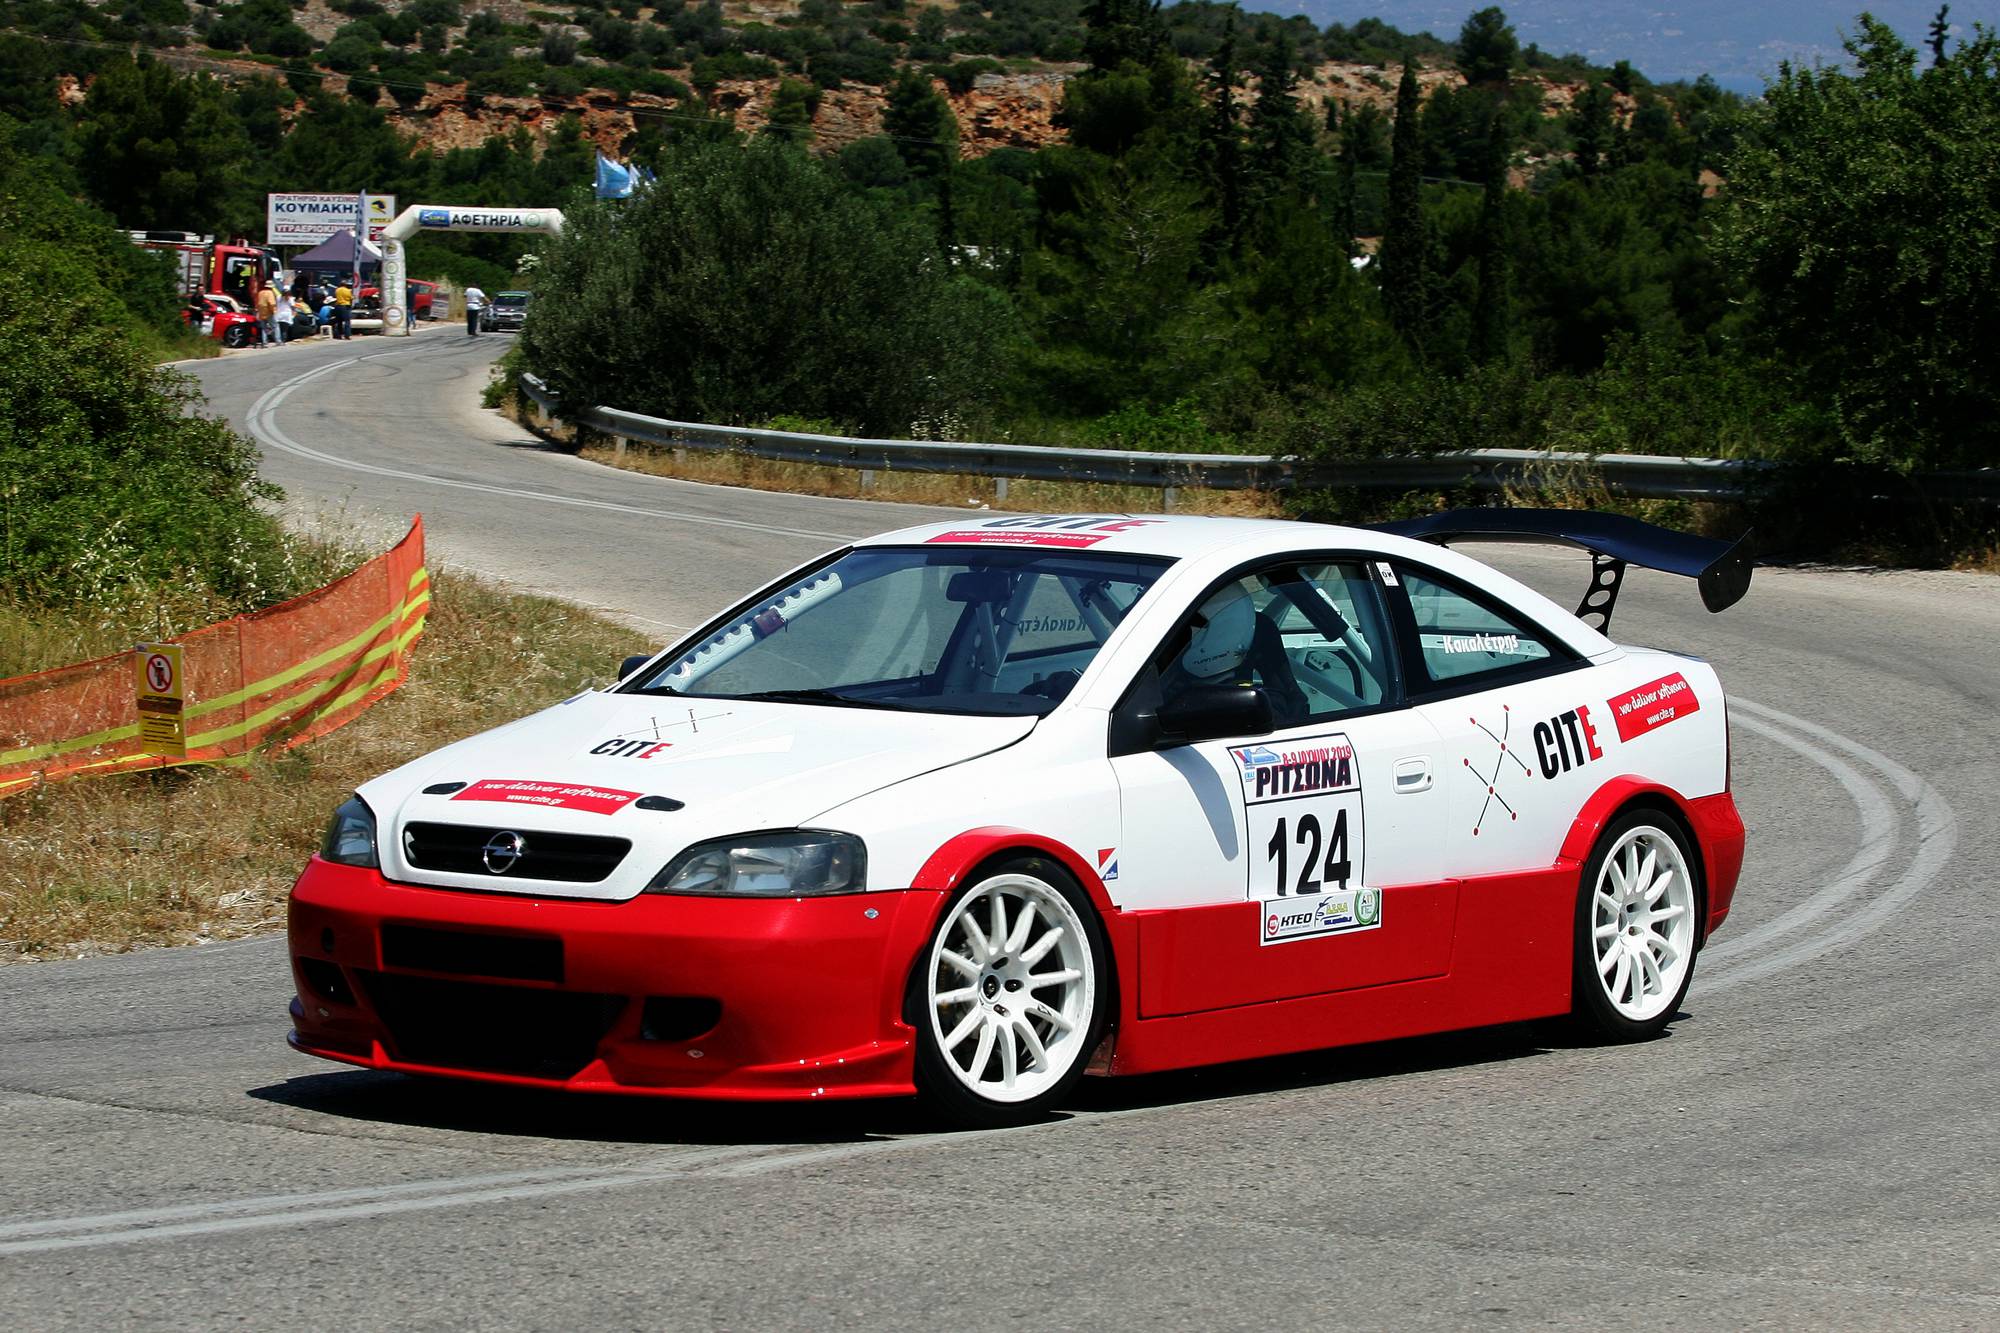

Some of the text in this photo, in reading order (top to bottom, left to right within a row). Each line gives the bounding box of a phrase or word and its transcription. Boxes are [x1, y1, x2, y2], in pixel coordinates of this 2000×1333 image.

[452, 214, 522, 227] ΑΦΕΤΗΡΙΑ
[981, 515, 1168, 532] CITE
[1443, 632, 1519, 654] Κακαλέτρης
[1631, 692, 1658, 710] deliver
[1657, 681, 1687, 700] software
[1646, 707, 1675, 725] www.cite.gr
[589, 739, 673, 759] CITE
[1533, 704, 1603, 780] CITE
[1256, 758, 1352, 798] ΡΙΤΣΩΝΑ
[506, 782, 562, 792] deliver
[559, 788, 630, 802] software
[506, 794, 565, 806] www.cite.gr
[1268, 809, 1351, 896] 124
